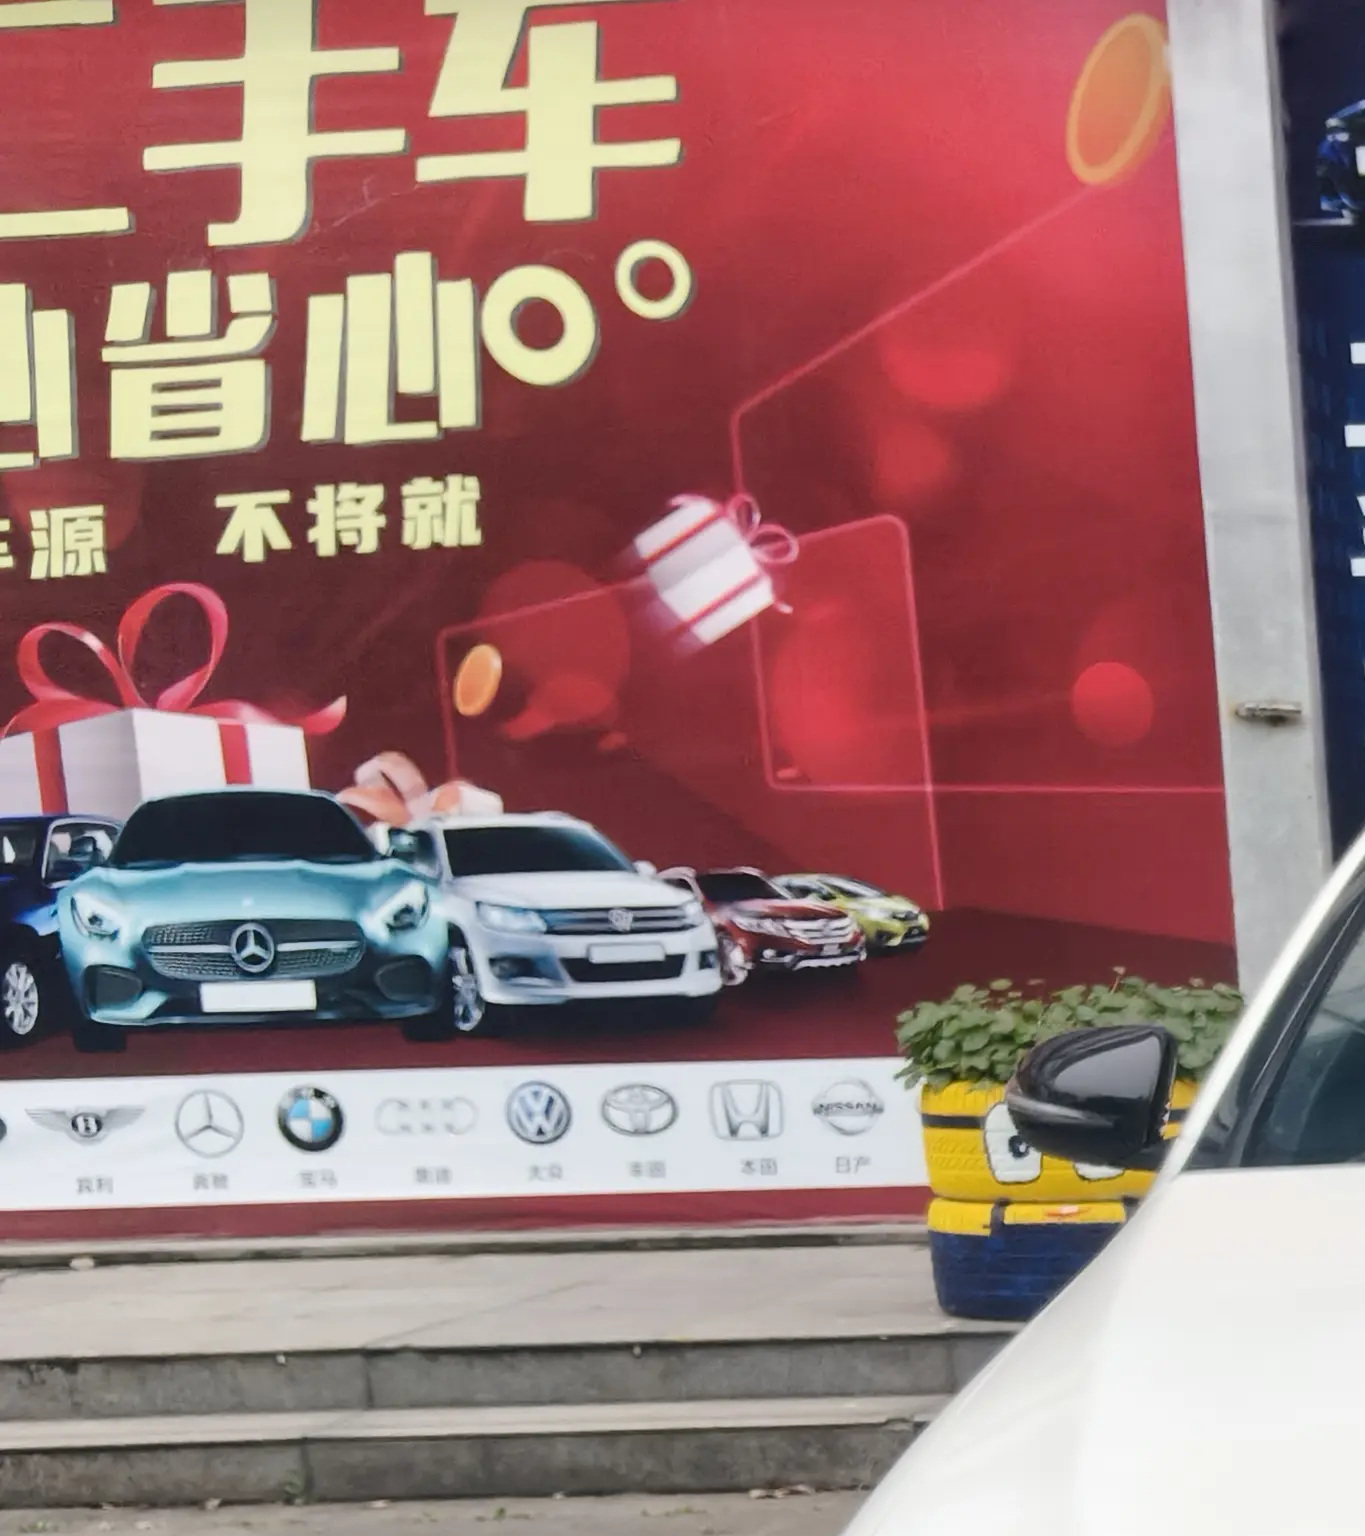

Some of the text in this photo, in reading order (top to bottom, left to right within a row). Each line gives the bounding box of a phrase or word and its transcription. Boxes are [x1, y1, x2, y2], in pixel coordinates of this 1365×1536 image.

[0, 474, 482, 581] 源 不将就
